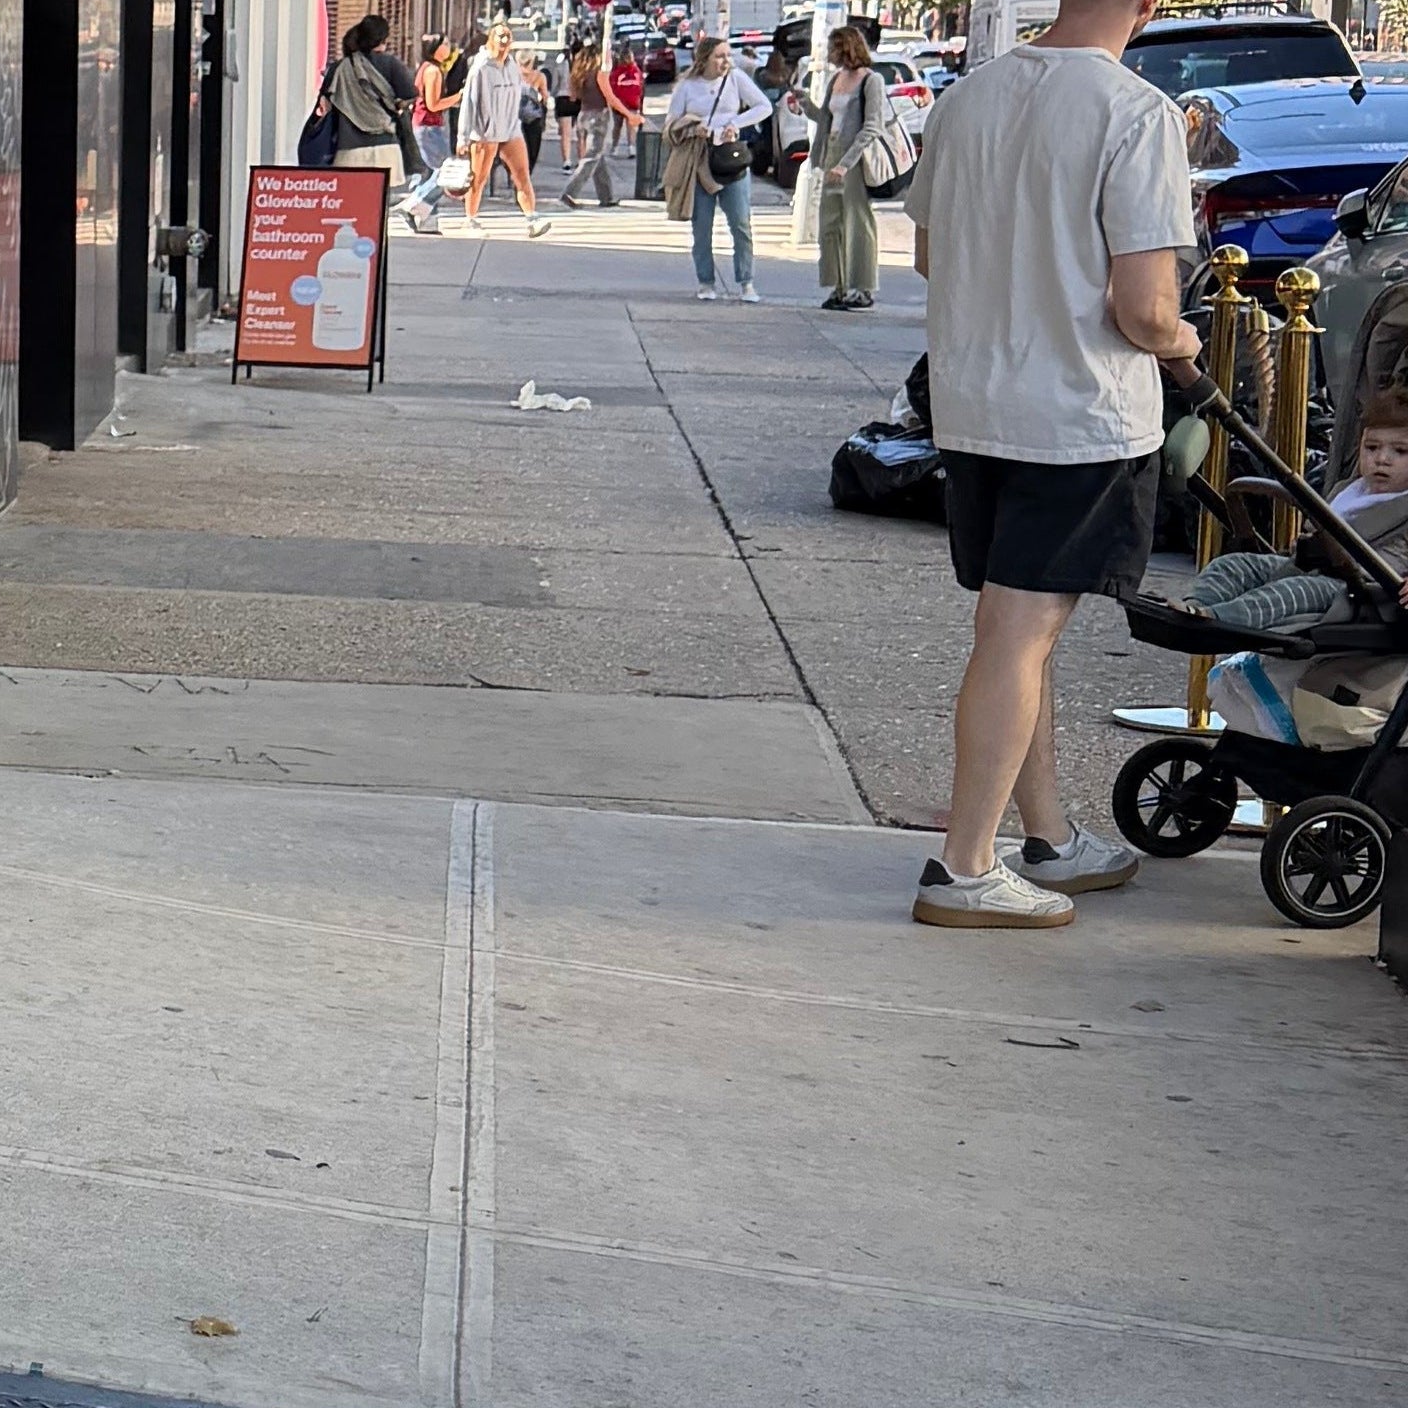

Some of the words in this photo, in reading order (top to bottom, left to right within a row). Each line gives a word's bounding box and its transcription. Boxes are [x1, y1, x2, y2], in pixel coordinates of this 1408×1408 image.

[257, 177, 282, 191] We
[284, 177, 338, 191] bottled
[321, 194, 343, 209] for
[254, 214, 287, 227] your
[252, 229, 324, 243] bathroom
[250, 248, 308, 260] counter
